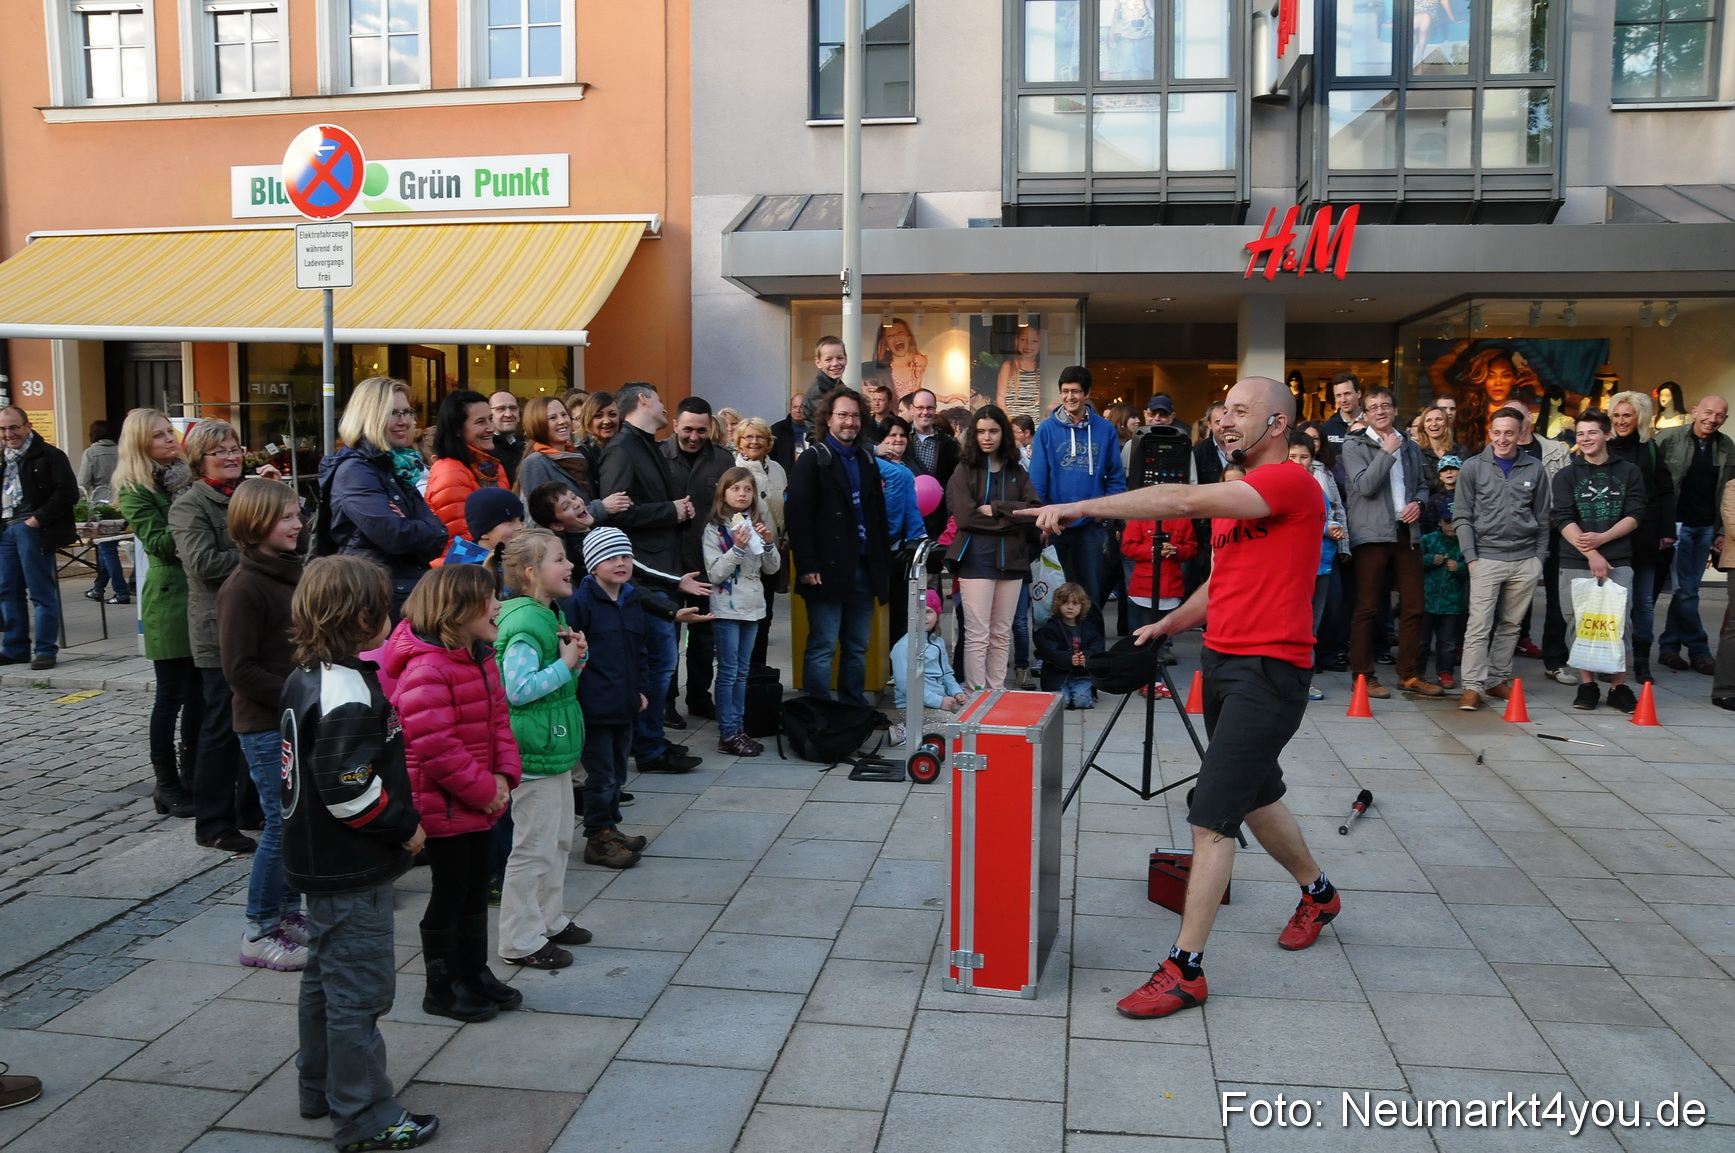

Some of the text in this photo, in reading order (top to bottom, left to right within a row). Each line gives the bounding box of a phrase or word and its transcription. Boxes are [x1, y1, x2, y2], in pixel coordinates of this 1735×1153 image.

[250, 167, 550, 206] Blu Grün Punkt
[299, 230, 349, 239] Elektrofahrzeuge
[305, 243, 344, 252] während des
[1244, 203, 1361, 282] H&M
[303, 258, 345, 268] Ladevorgangs
[318, 271, 331, 281] frei
[21, 380, 44, 397] 39
